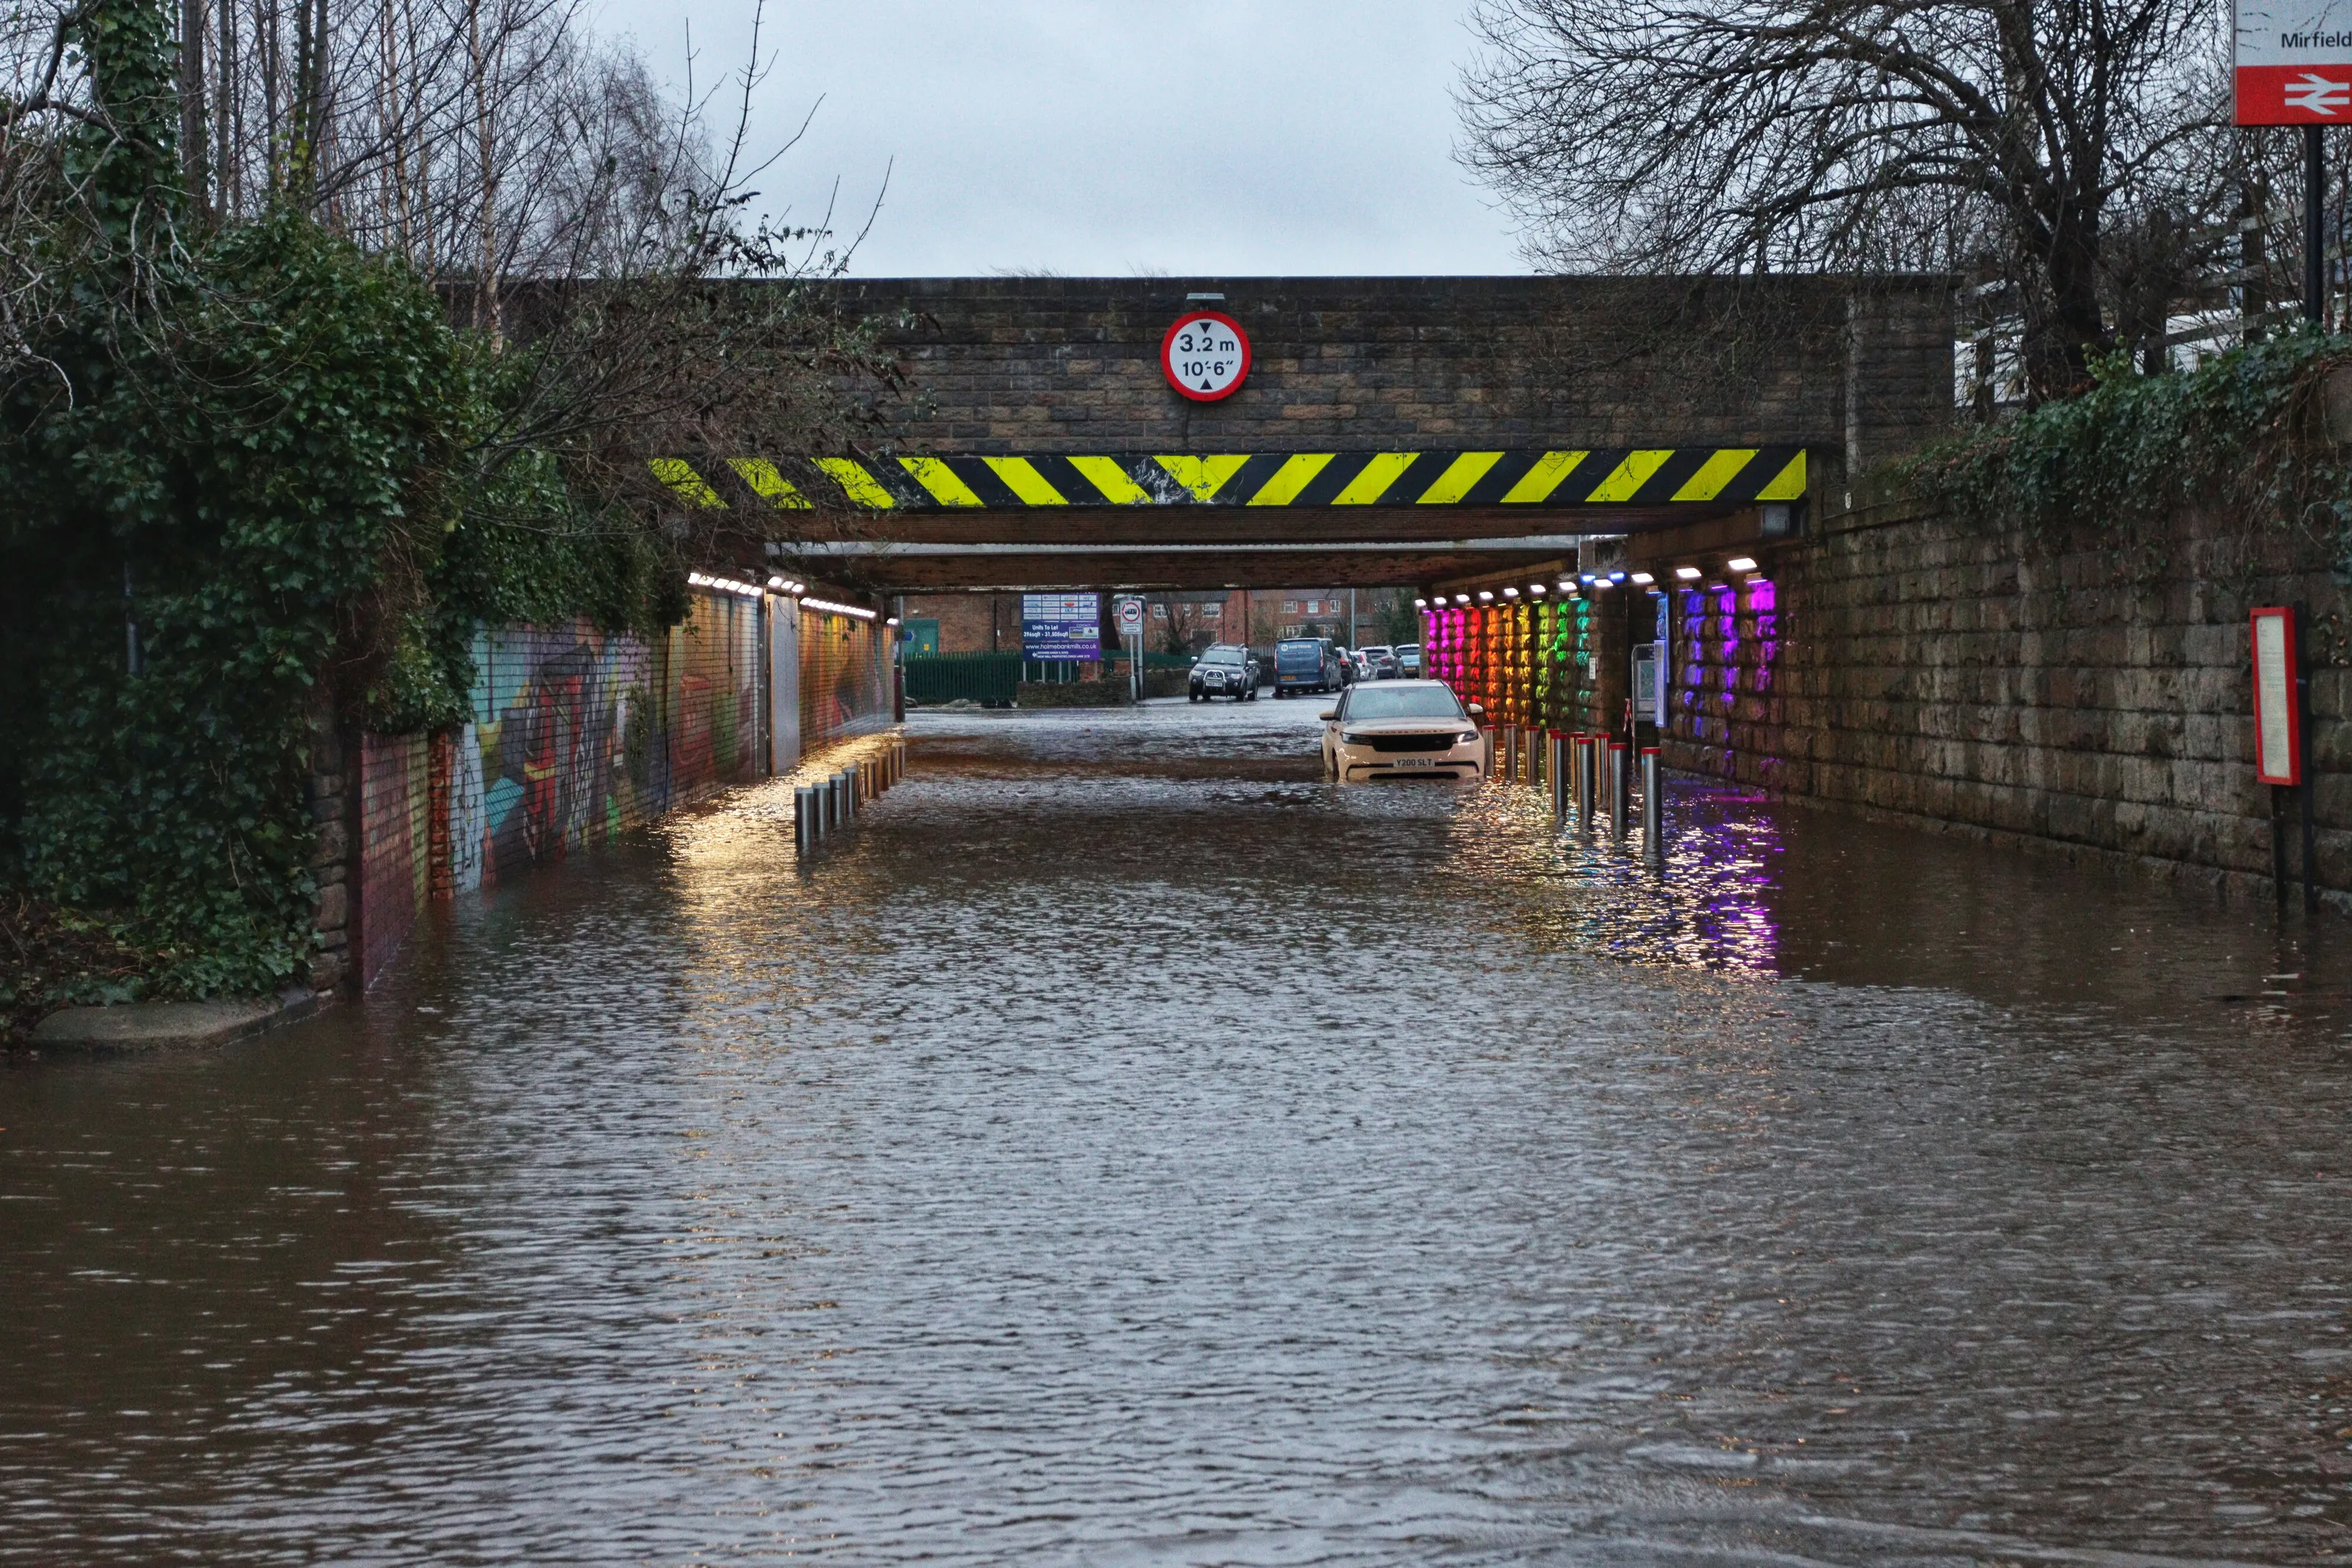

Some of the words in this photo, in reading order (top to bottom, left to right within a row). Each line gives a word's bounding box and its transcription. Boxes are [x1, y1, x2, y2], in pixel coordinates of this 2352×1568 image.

[2281, 32, 2352, 48] Mirfield
[1180, 334, 1213, 352] 3.2
[1219, 340, 1235, 351] m
[1396, 758, 1416, 766] Y200
